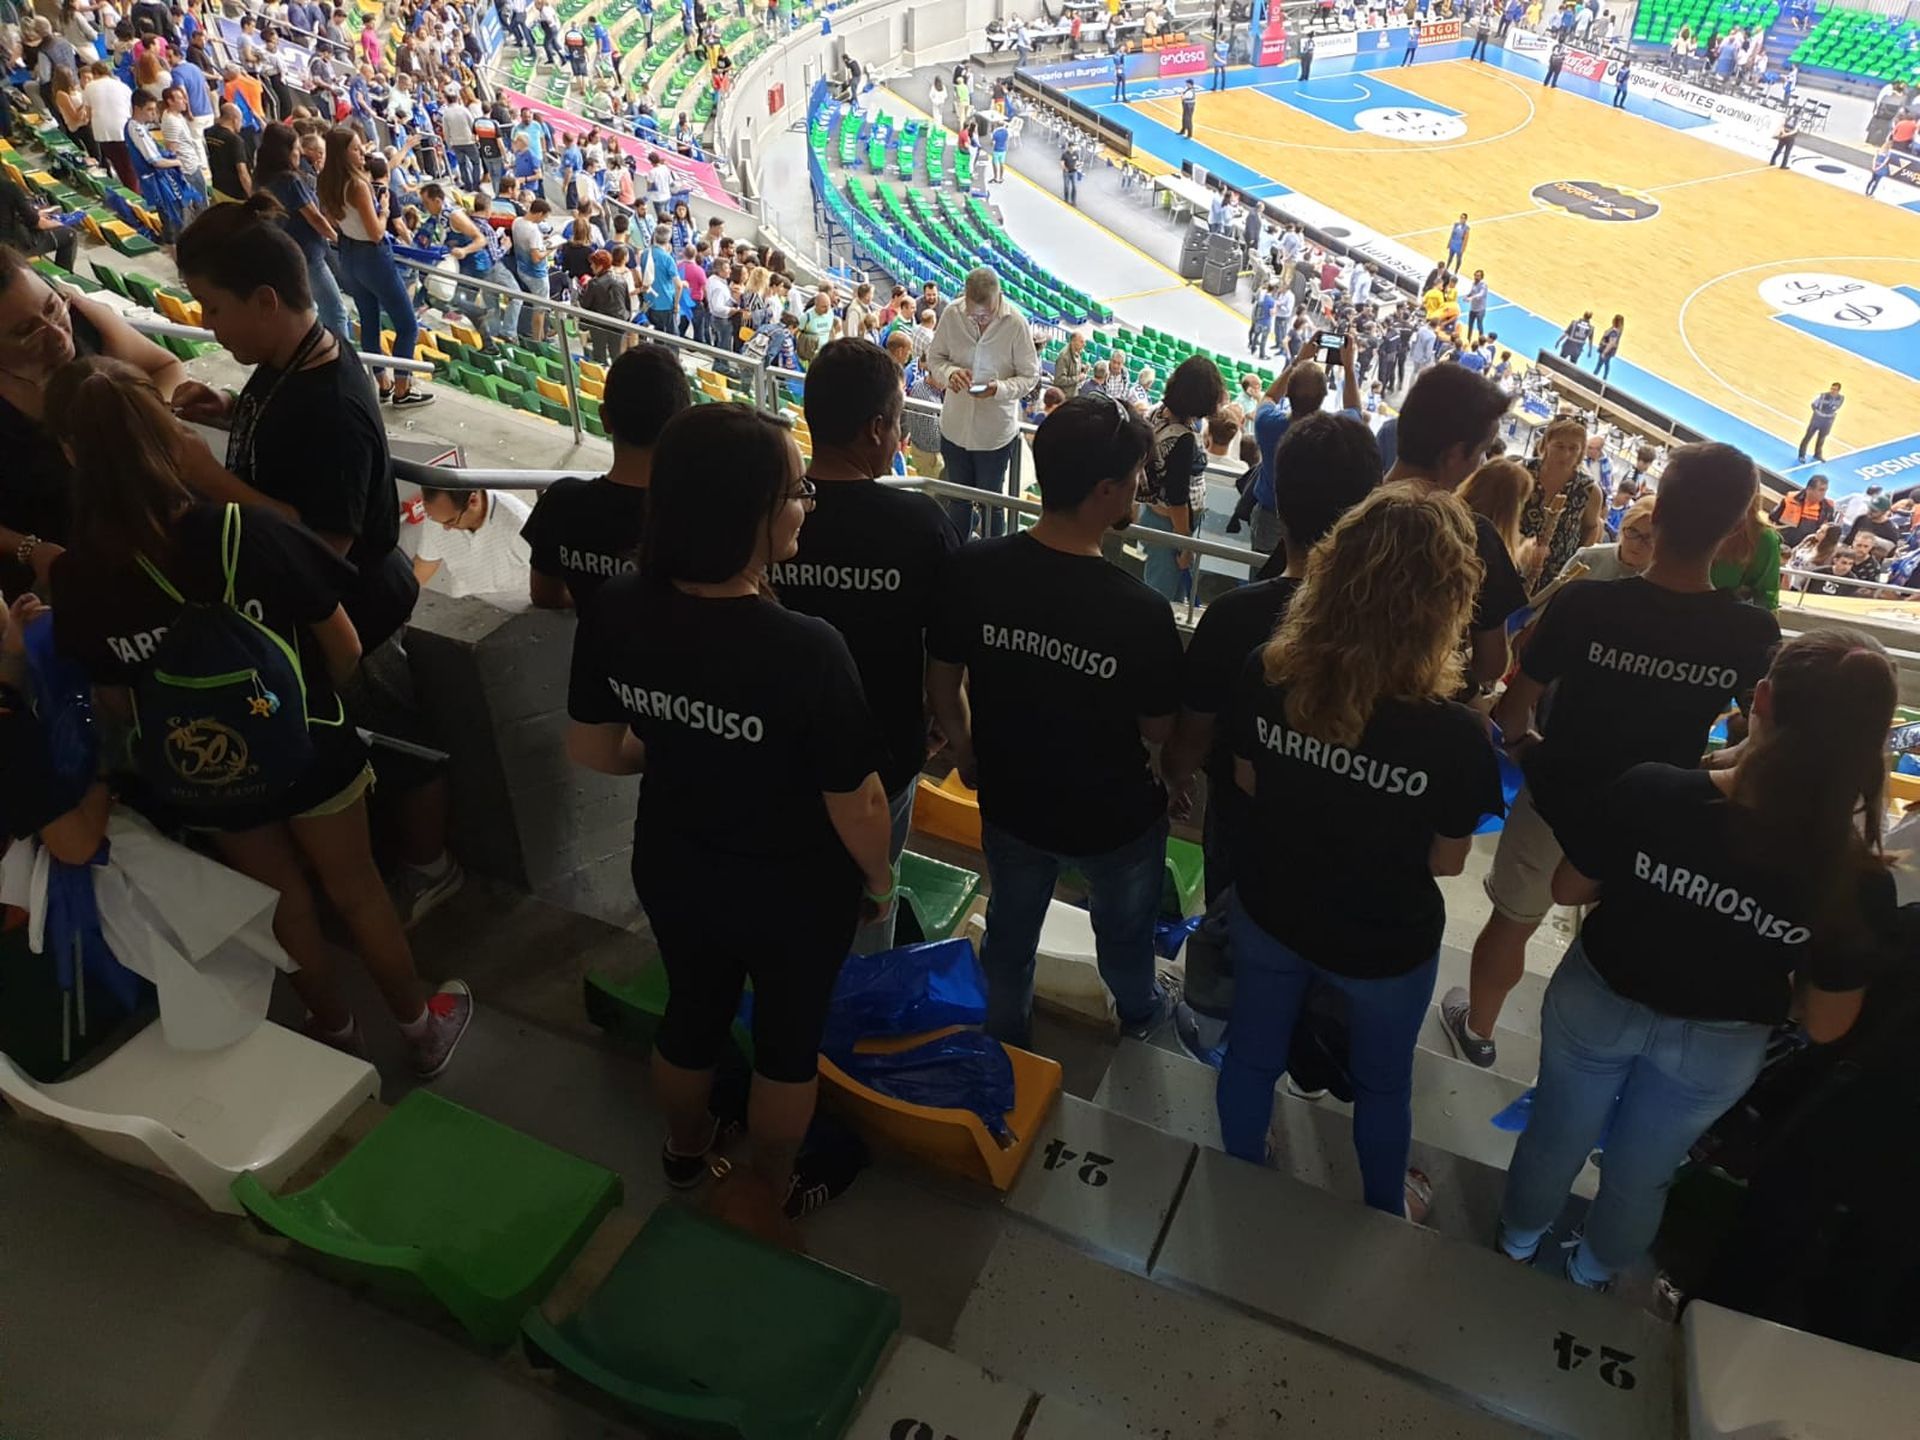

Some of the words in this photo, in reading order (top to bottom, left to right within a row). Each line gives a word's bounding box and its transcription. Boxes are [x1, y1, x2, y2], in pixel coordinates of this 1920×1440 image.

[1160, 50, 1206, 66] endesa
[982, 623, 1118, 680] BARRIOSUSO
[1588, 641, 1738, 691] BARRIOSUSO
[1256, 716, 1429, 797] BARRIOSUSO
[1635, 851, 1812, 945] BARRIOSUSO
